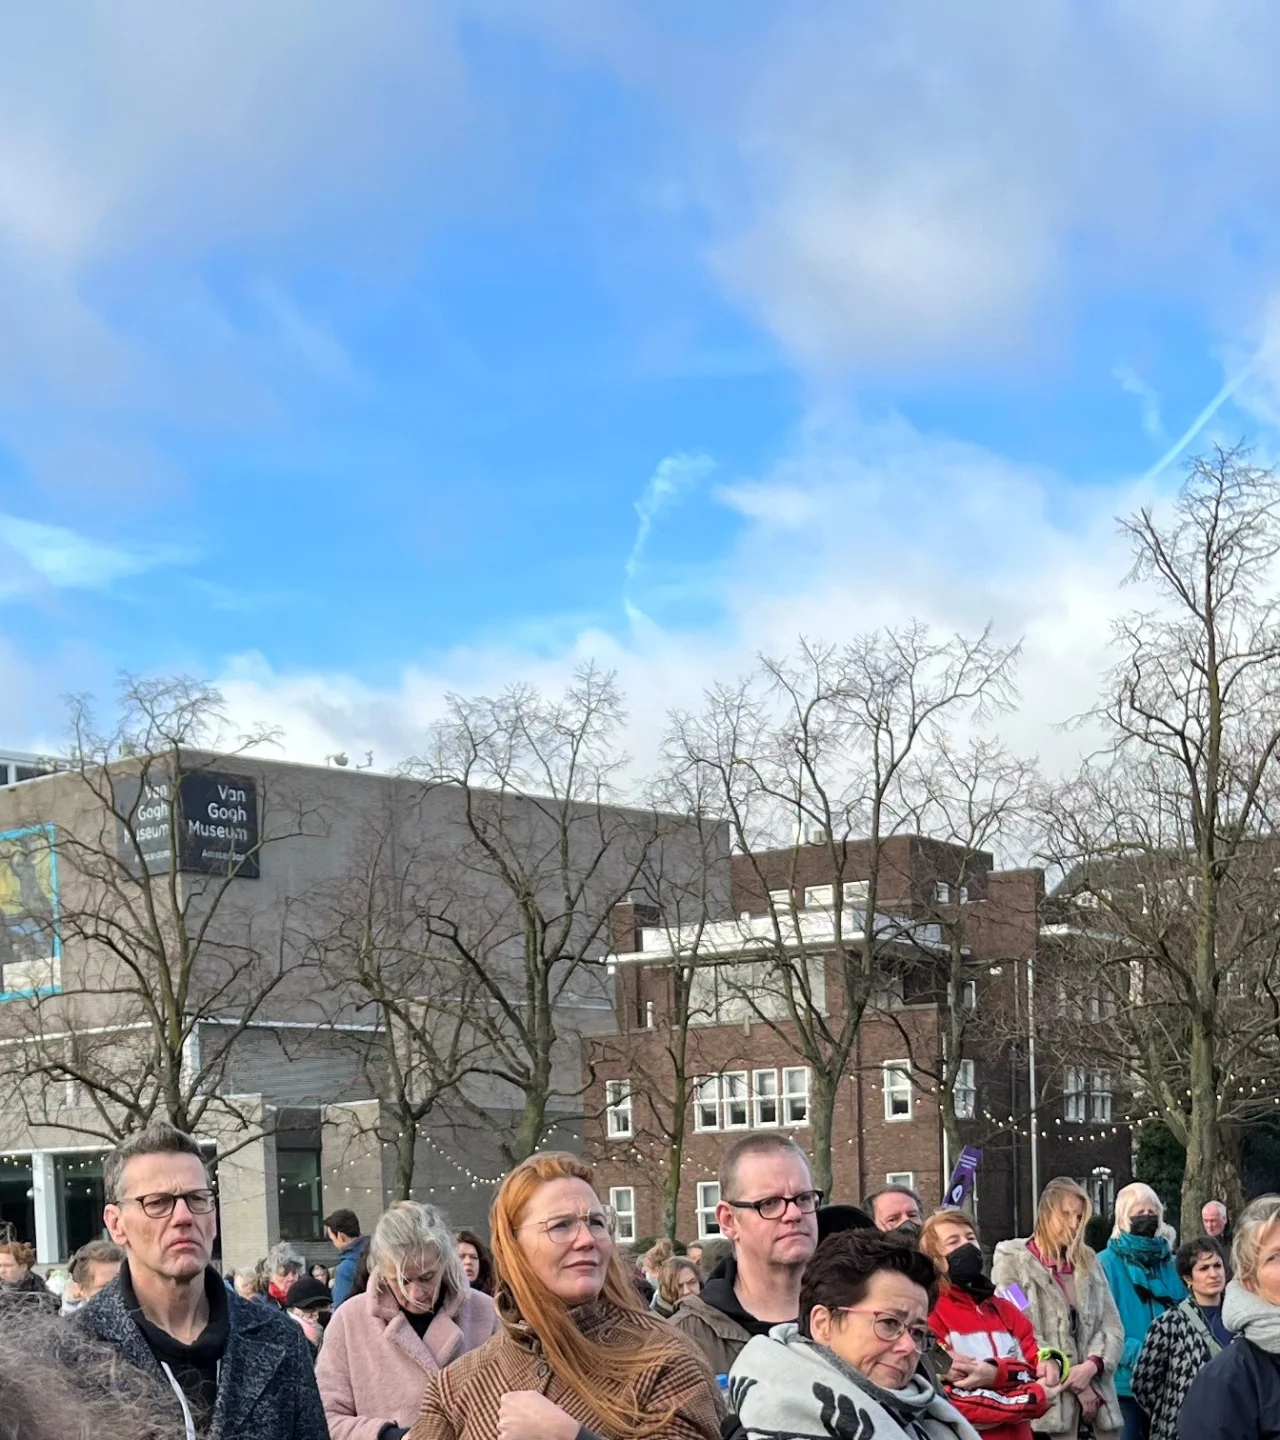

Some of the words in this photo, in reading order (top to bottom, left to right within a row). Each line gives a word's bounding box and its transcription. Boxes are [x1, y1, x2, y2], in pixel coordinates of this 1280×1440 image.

[144, 784, 168, 799] Van
[217, 785, 246, 802] Van
[137, 801, 169, 820] Gogh
[207, 802, 247, 822] Gogh
[188, 820, 247, 840] Museum
